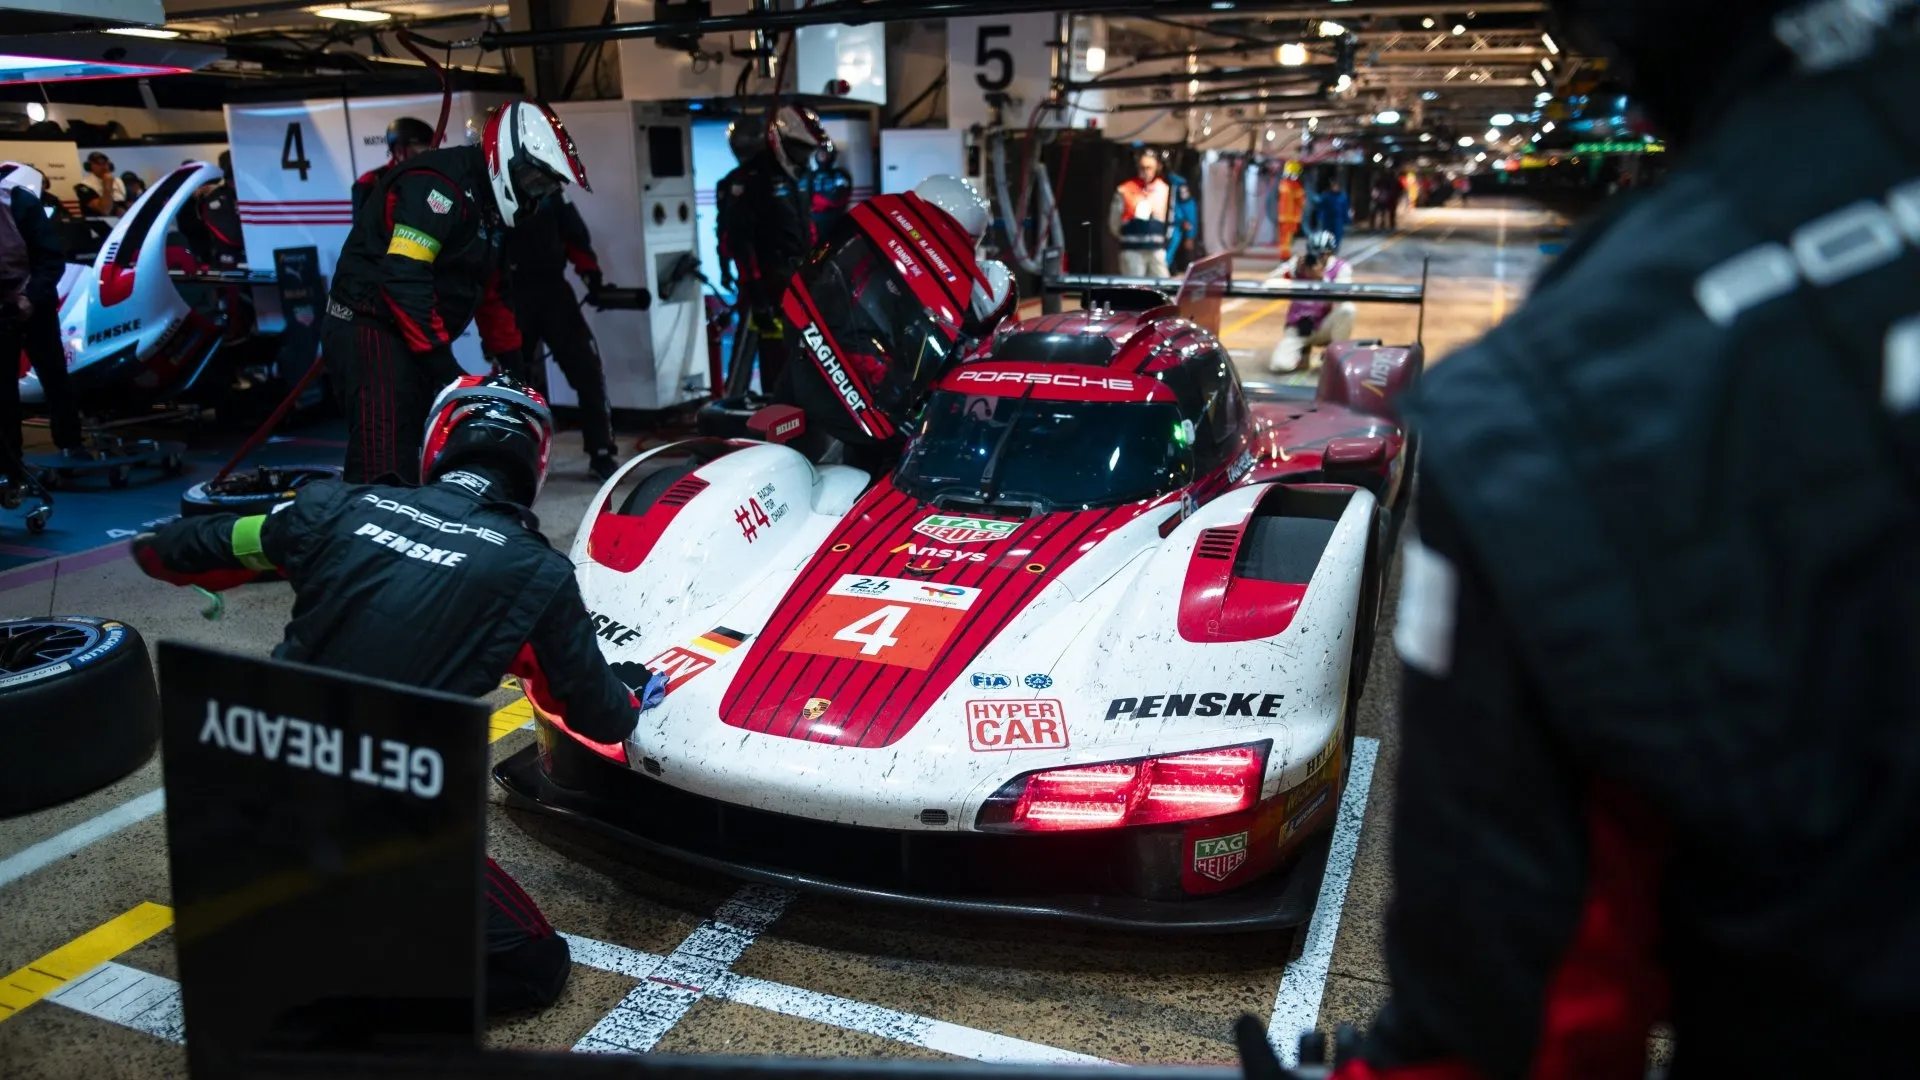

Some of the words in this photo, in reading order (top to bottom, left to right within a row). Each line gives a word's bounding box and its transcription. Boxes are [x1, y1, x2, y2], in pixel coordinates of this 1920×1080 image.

[976, 25, 1014, 91] 5
[281, 122, 311, 181] 4
[87, 318, 142, 346] PENSKE
[957, 370, 1134, 391] PORSCHE
[757, 482, 776, 500] RACING
[764, 498, 776, 511] FOR
[361, 493, 509, 547] PORSCHE
[734, 497, 771, 544] #4
[920, 525, 1010, 542] HEUER
[937, 516, 1013, 531] TAG
[353, 522, 468, 568] PENSKE
[890, 542, 988, 563] Ansys
[832, 604, 912, 656] 4
[78, 629, 123, 662] MICHELIN
[973, 703, 1056, 719] HYPER
[1104, 692, 1285, 721] PENSKE
[199, 698, 343, 777] READY
[976, 718, 1060, 746] CAR
[350, 734, 444, 798] GET
[1200, 836, 1243, 855] TAG
[1197, 851, 1245, 878] HEUER
